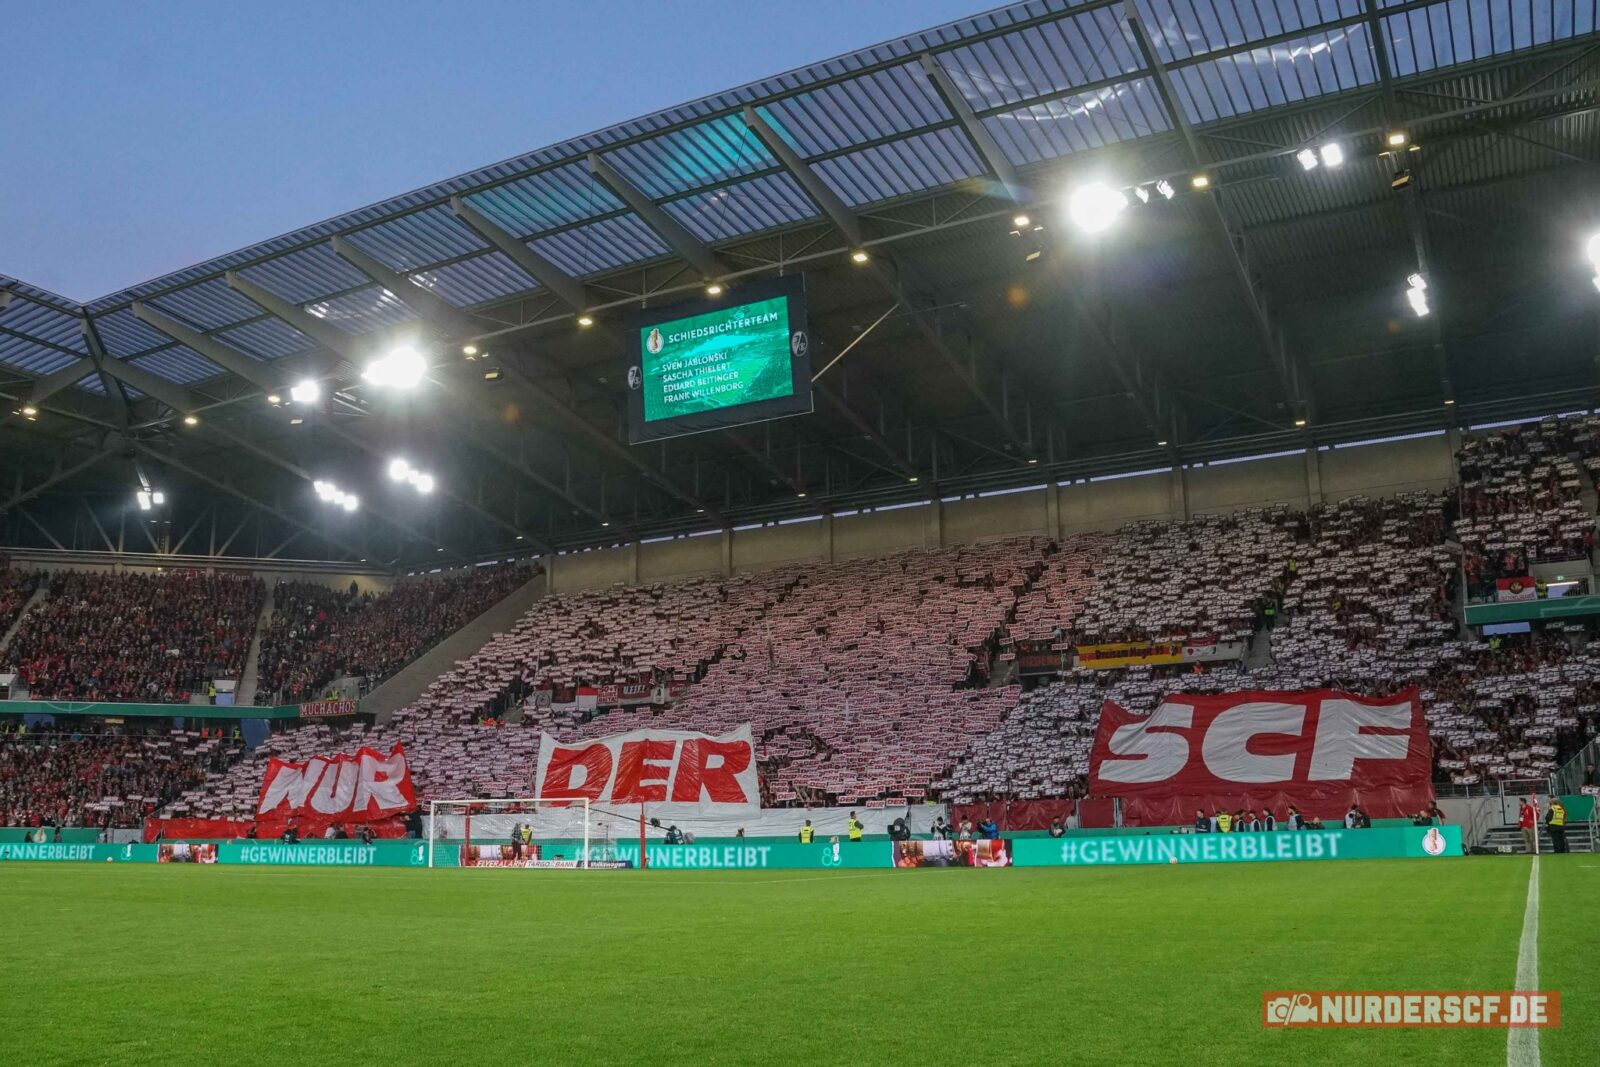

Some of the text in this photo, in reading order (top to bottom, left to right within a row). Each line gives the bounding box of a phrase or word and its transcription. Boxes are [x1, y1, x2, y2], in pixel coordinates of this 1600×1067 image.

[668, 312, 778, 343] SCHIEDSRICHTERTEAM
[662, 352, 728, 372] SVEN JABLONSKI
[663, 362, 731, 382] SASCHA THIELERT
[664, 372, 739, 393] EDUARD BEITINGER
[664, 382, 744, 403] FRANK WILLENBORG
[301, 701, 356, 715] MUCHACHOS
[1098, 698, 1412, 783] SCF
[540, 737, 751, 806] DER
[260, 753, 408, 814] NUR
[240, 846, 376, 864] #GEWINNERBLEIBT
[576, 846, 770, 867] #GWINNERBLEIBT
[1061, 832, 1342, 862] #GEWINNERBLEIBT
